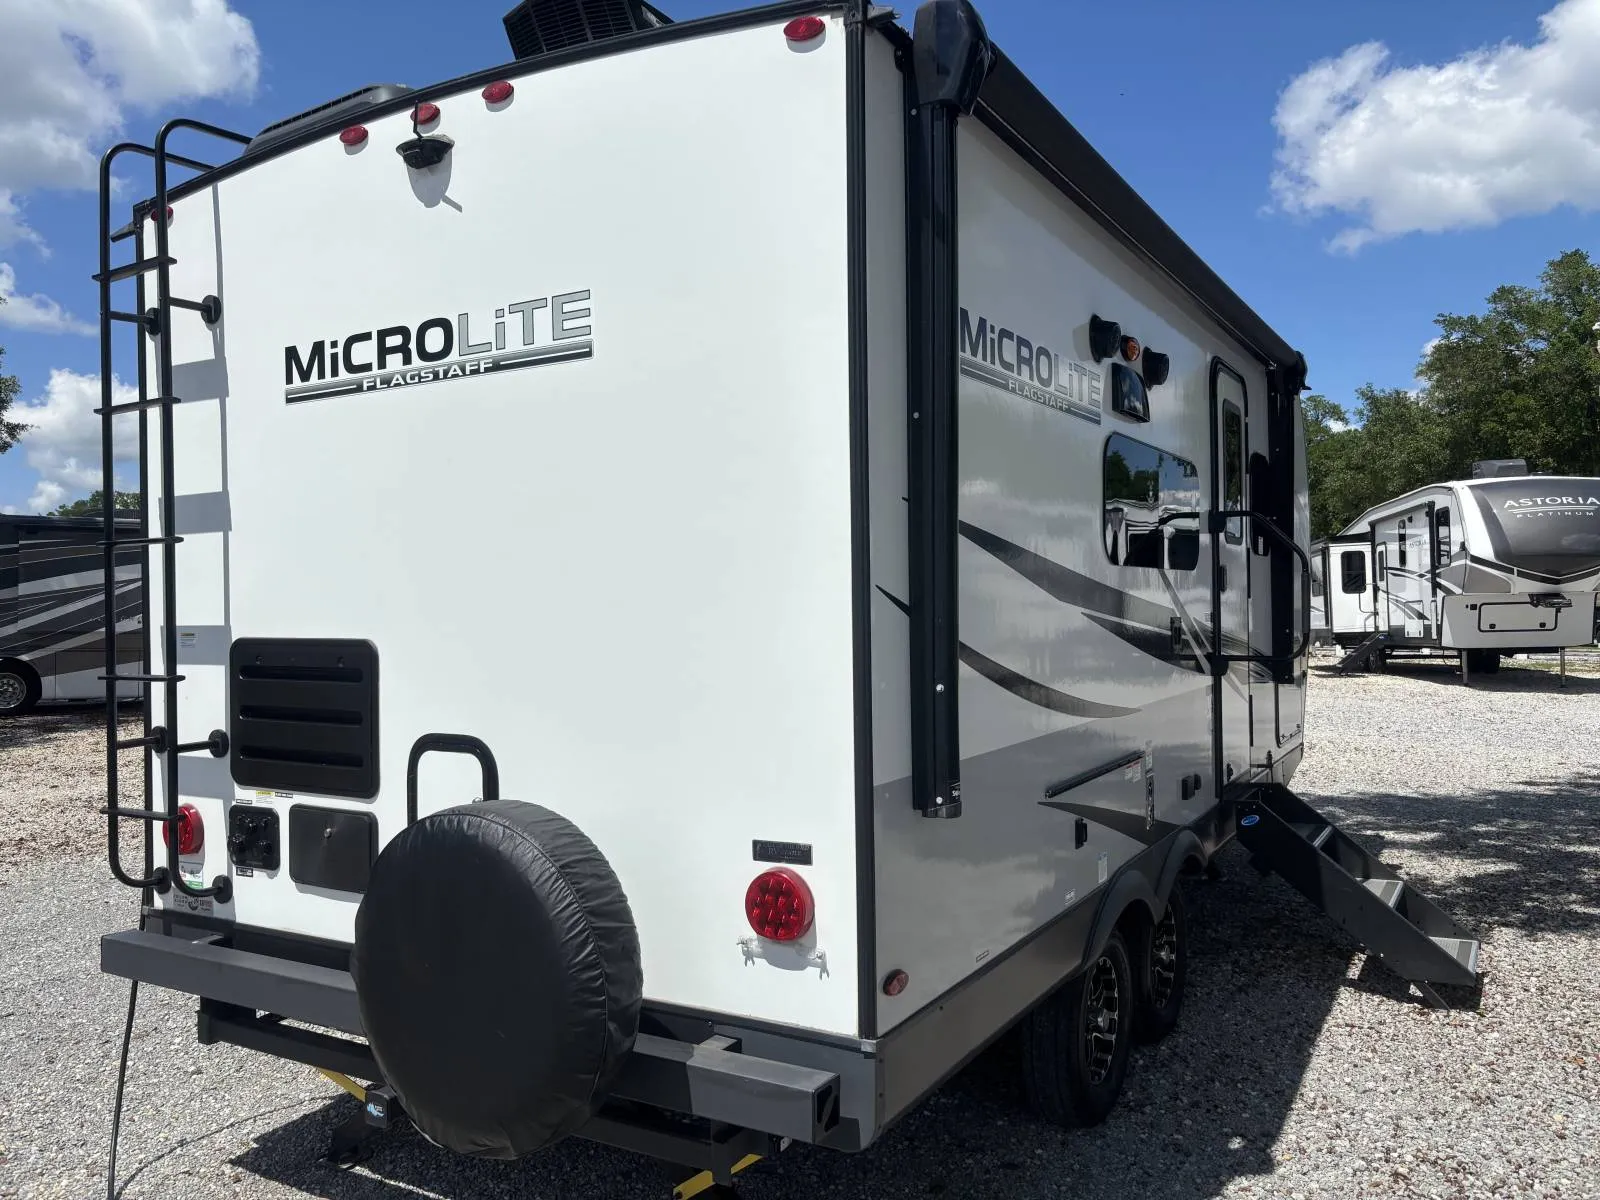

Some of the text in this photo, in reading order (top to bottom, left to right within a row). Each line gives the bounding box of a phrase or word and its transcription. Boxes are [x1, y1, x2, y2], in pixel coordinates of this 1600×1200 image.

[362, 358, 493, 391] FLAGSTAFF
[1008, 379, 1069, 412] FLAGSTAFF
[1503, 496, 1600, 509] ASTORIA
